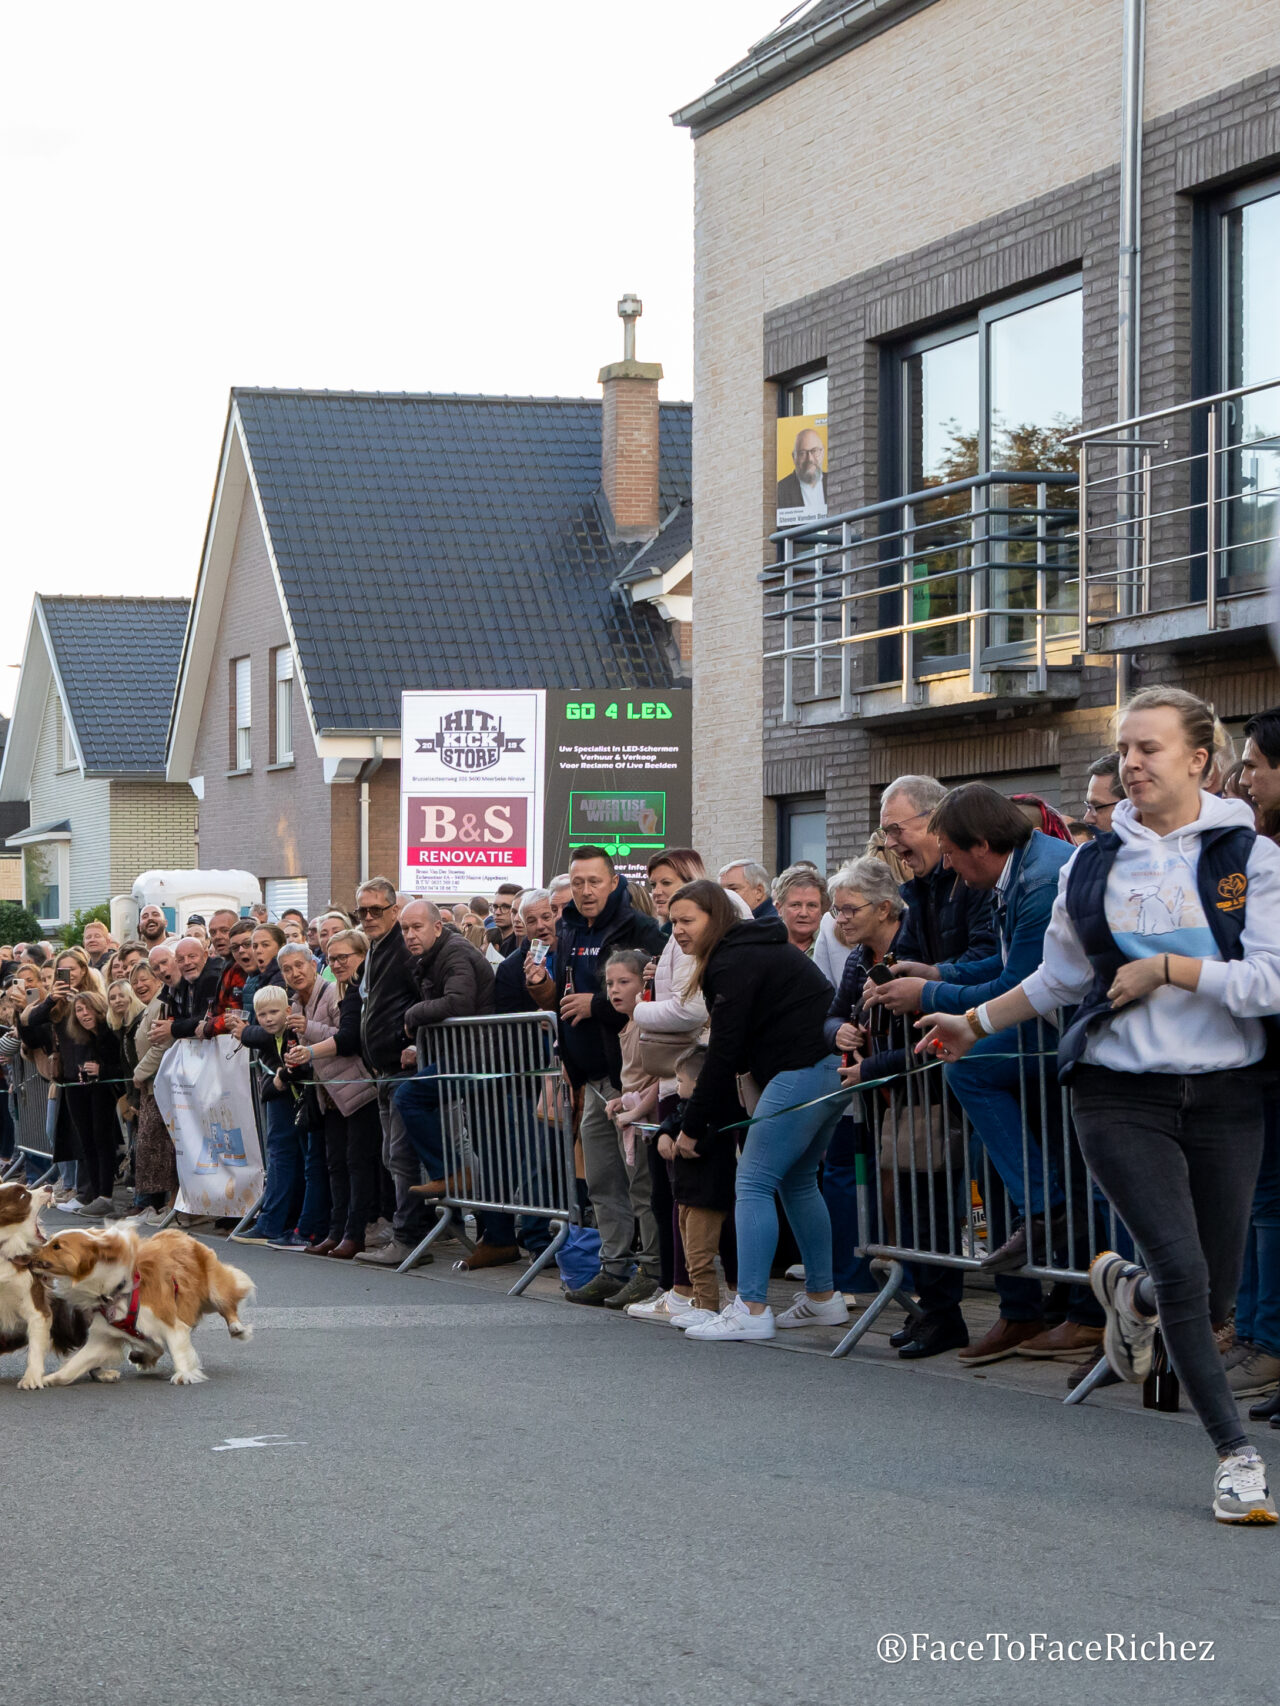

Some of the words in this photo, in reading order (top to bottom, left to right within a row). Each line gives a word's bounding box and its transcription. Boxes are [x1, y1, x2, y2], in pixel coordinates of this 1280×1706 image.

[566, 703, 596, 720] GO
[604, 703, 618, 720] 4
[627, 702, 673, 720] LED
[444, 709, 494, 731] HIT
[443, 732, 498, 747] KICK
[573, 745, 611, 753] Specialist
[444, 748, 497, 768] STORE
[622, 754, 657, 762] Verkoop
[580, 799, 647, 811] ADVERTISE
[587, 810, 620, 822] WITH
[622, 810, 641, 822] US
[420, 805, 514, 843] B&S
[419, 850, 513, 863] RENOVATIE
